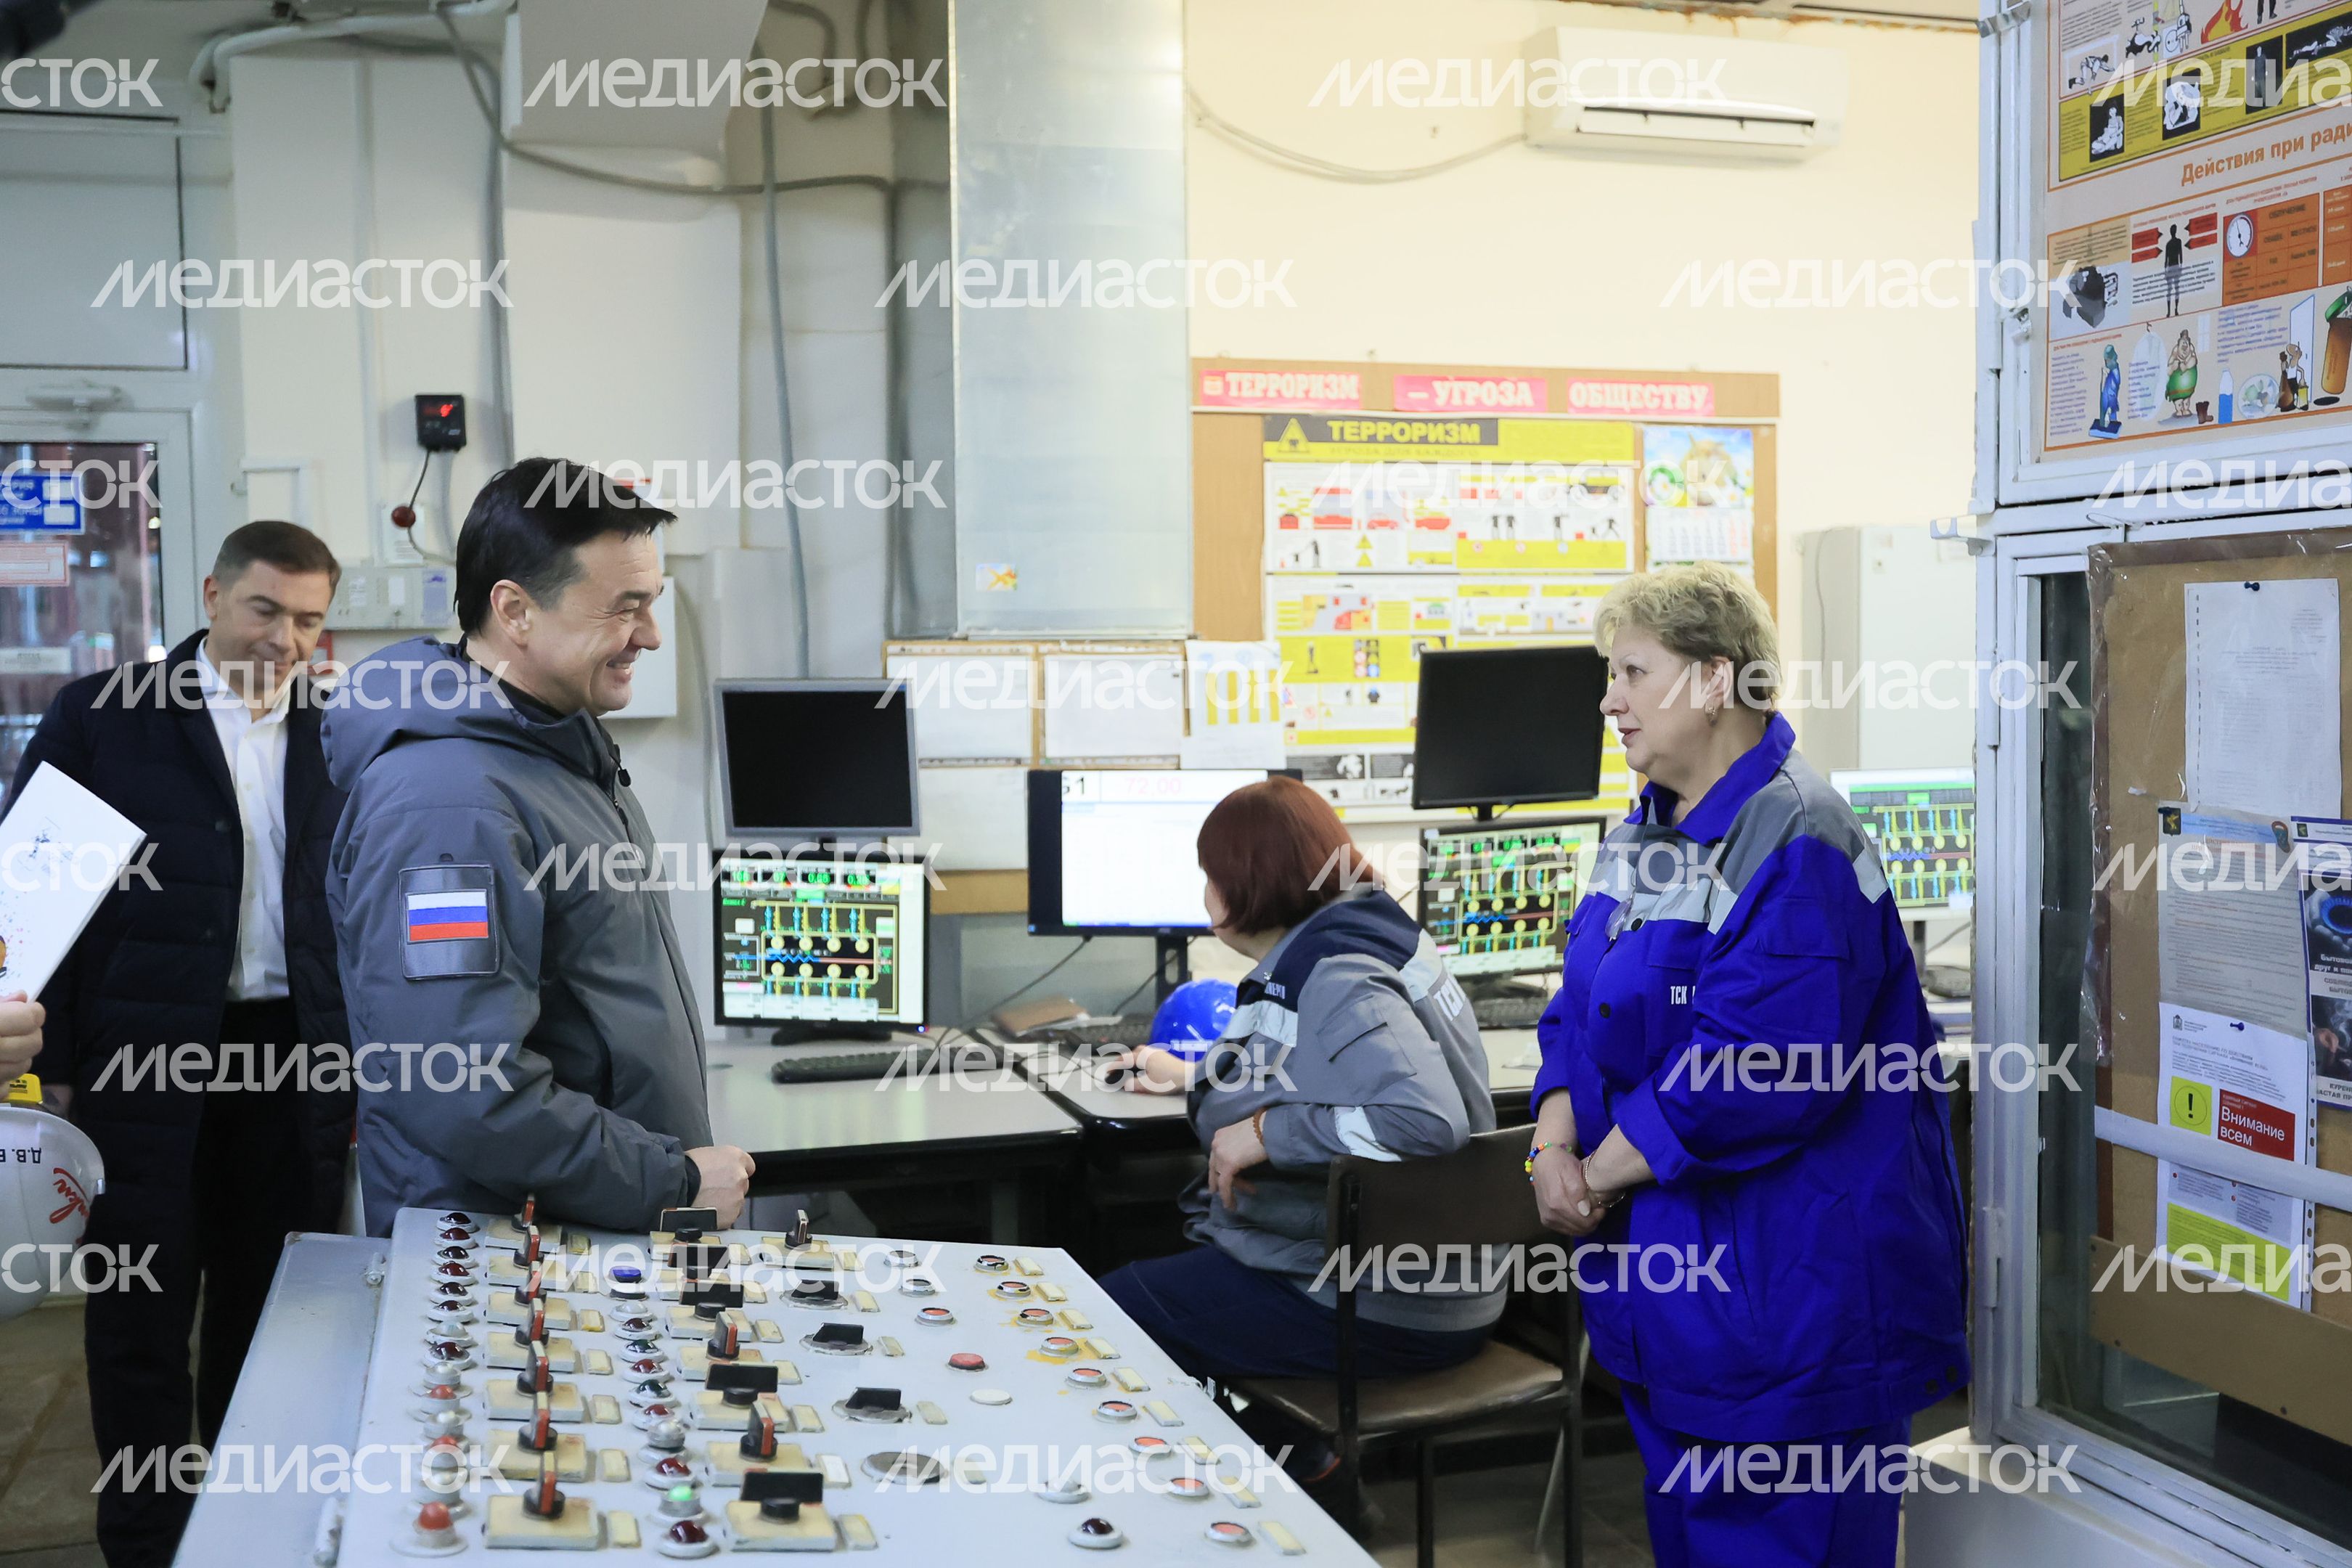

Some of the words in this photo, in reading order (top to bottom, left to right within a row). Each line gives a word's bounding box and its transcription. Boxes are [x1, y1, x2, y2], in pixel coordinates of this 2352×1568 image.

[2181, 147, 2265, 187] Действия
[2271, 136, 2305, 160] при
[1225, 372, 1360, 400] ТЕРРОРИЗМ
[1433, 380, 1535, 408] УГРОЗА
[1569, 382, 1709, 412] ОБЩЕСТВУ
[1326, 420, 1481, 444] ТЕРРОРИЗМ
[2221, 1105, 2285, 1141] Внимание
[2221, 1126, 2253, 1146] всем
